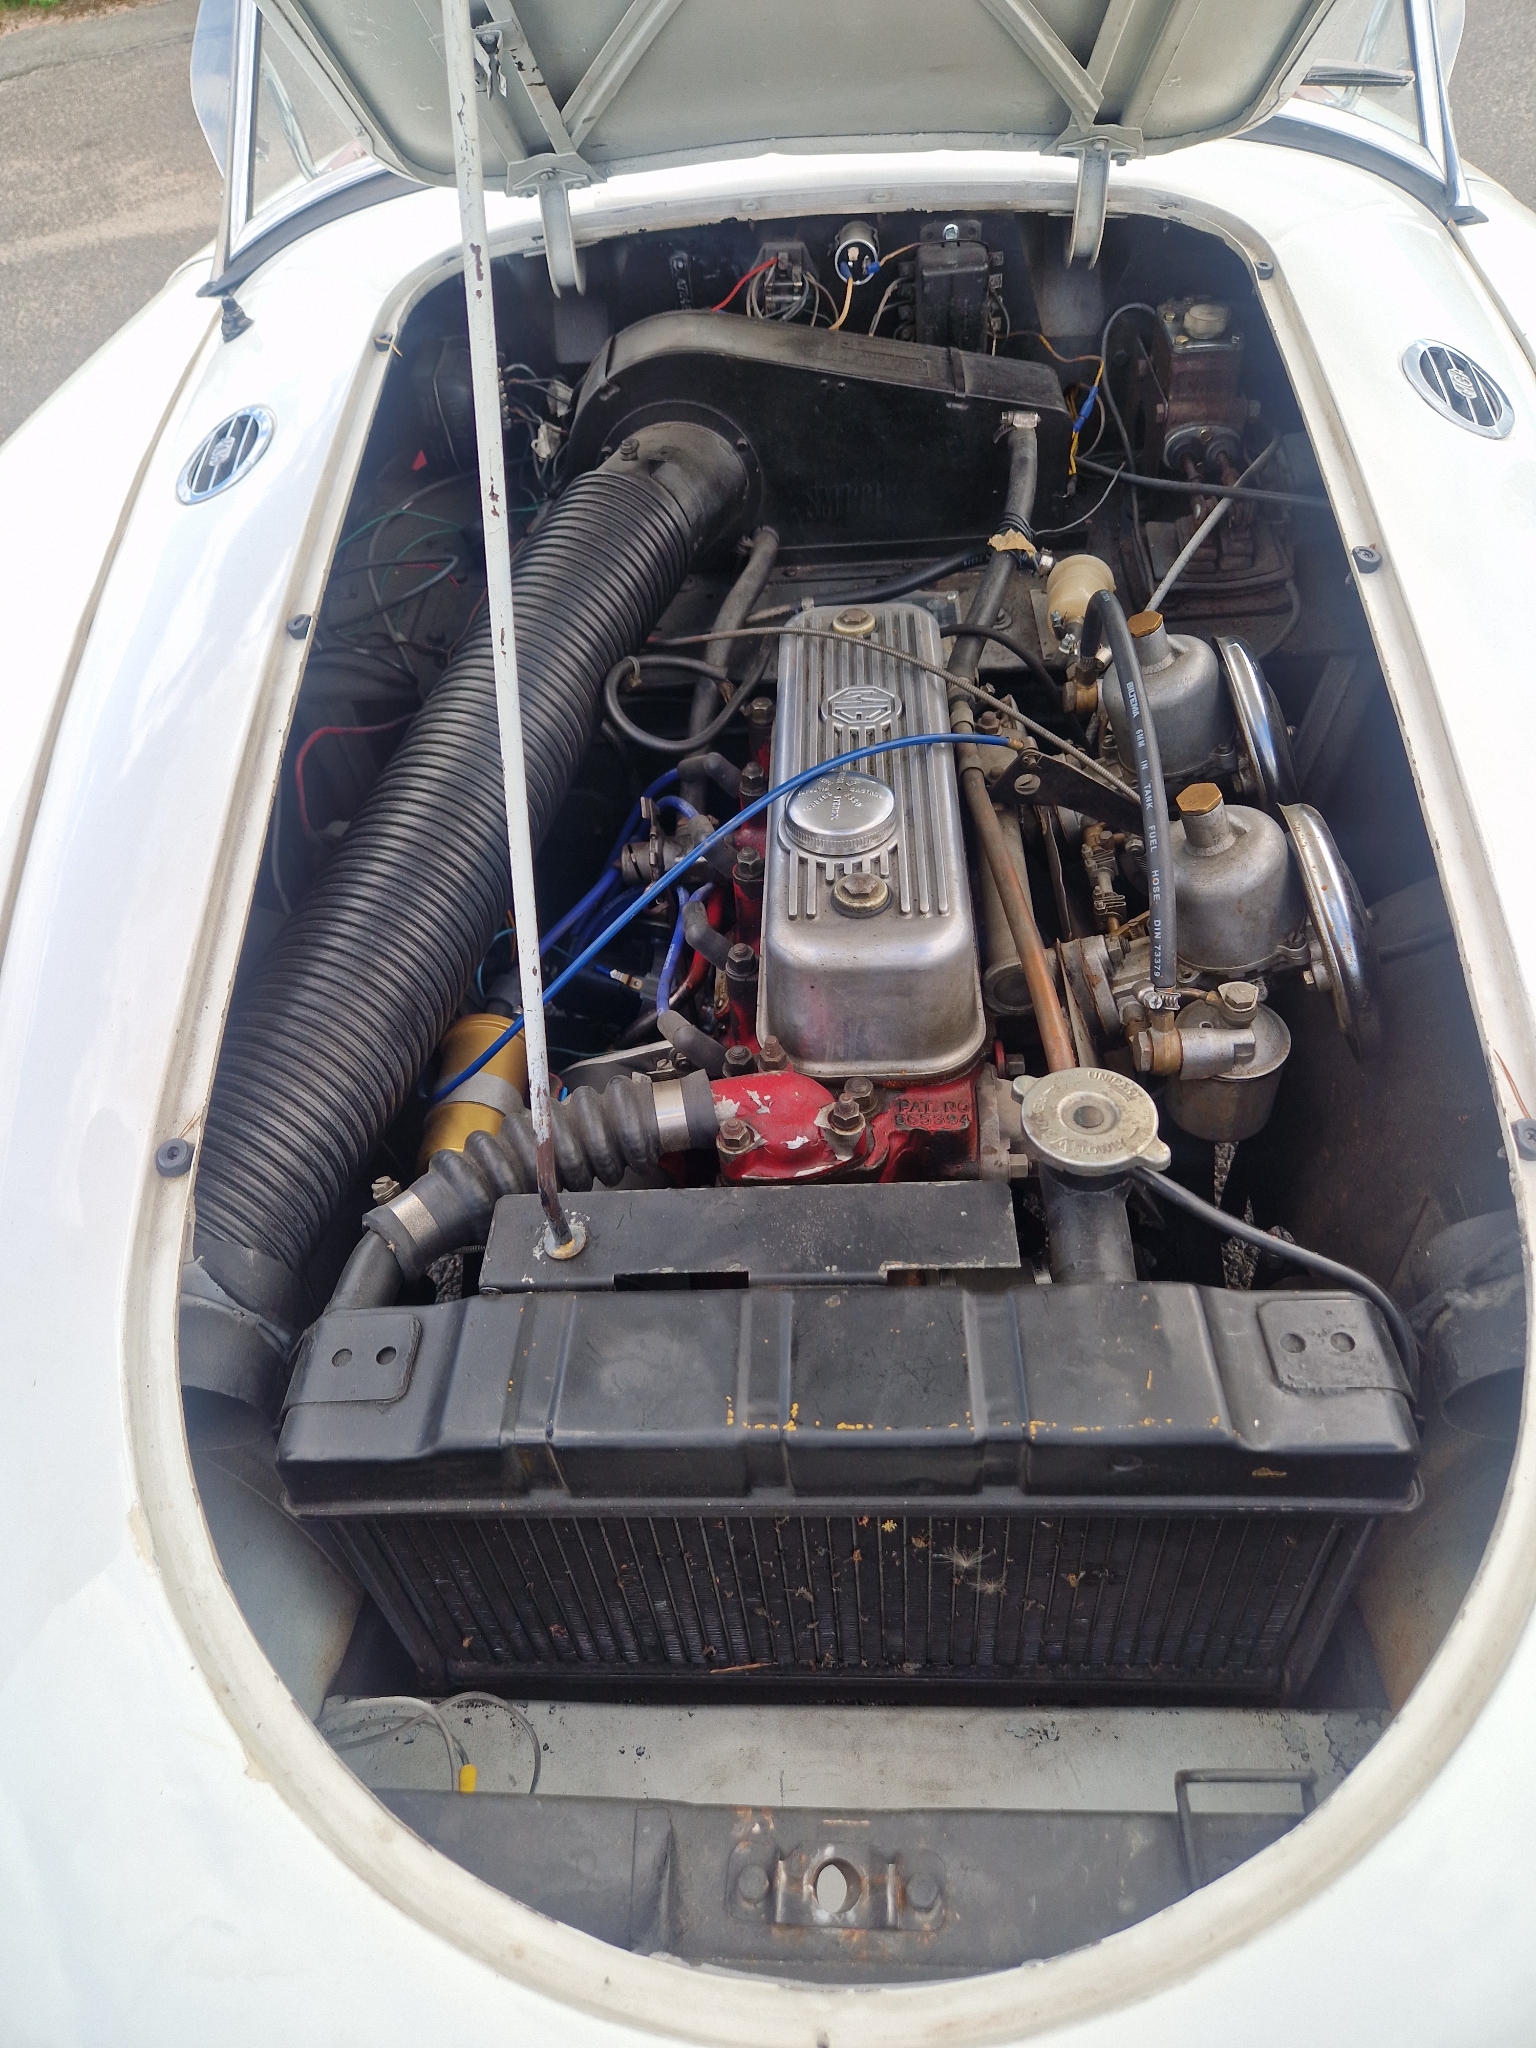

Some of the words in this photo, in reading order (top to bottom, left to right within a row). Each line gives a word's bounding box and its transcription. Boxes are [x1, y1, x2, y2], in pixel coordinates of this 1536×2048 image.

[1126, 681, 1140, 718] BILTEMA
[1136, 729, 1145, 747] 6MM
[1141, 760, 1149, 770] IN
[1144, 783, 1154, 810] TANK
[1149, 825, 1158, 852] FUEL
[1152, 870, 1160, 900] HOSE
[1087, 1070, 1143, 1098] UNIPART
